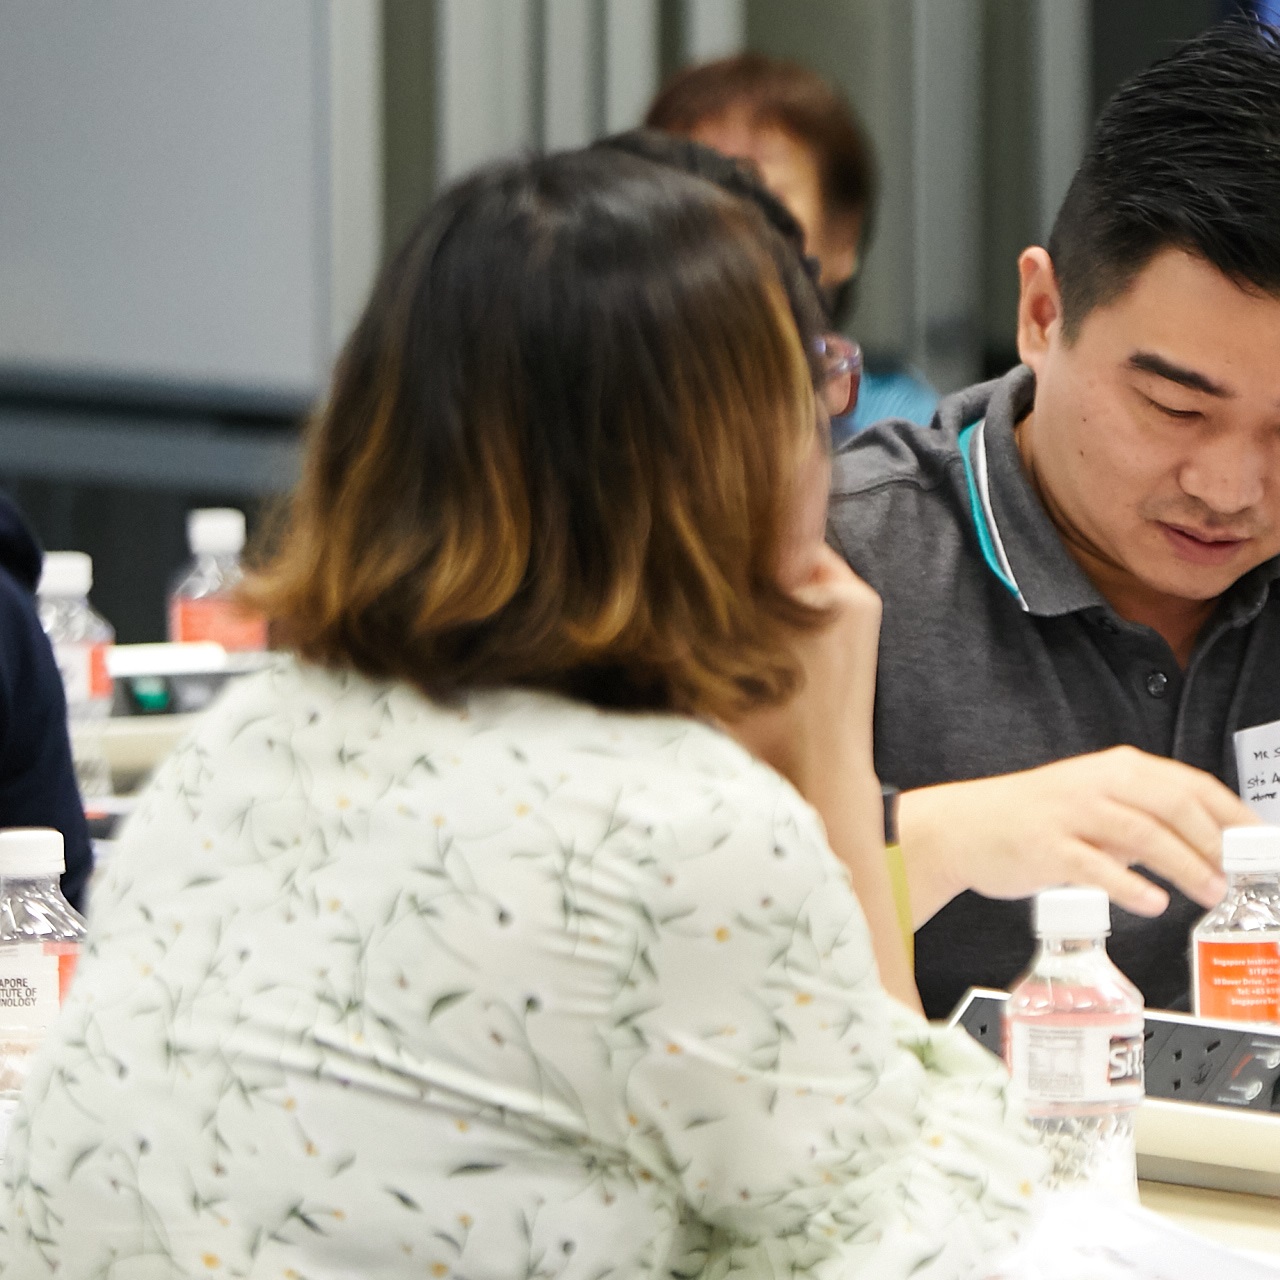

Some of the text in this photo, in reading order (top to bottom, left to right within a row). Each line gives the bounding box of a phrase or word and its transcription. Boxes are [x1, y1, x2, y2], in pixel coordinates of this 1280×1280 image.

[1213, 958, 1246, 967] Singapore
[0, 978, 28, 988] APORE
[26, 987, 37, 997] OF
[0, 998, 36, 1007] NOLOGY
